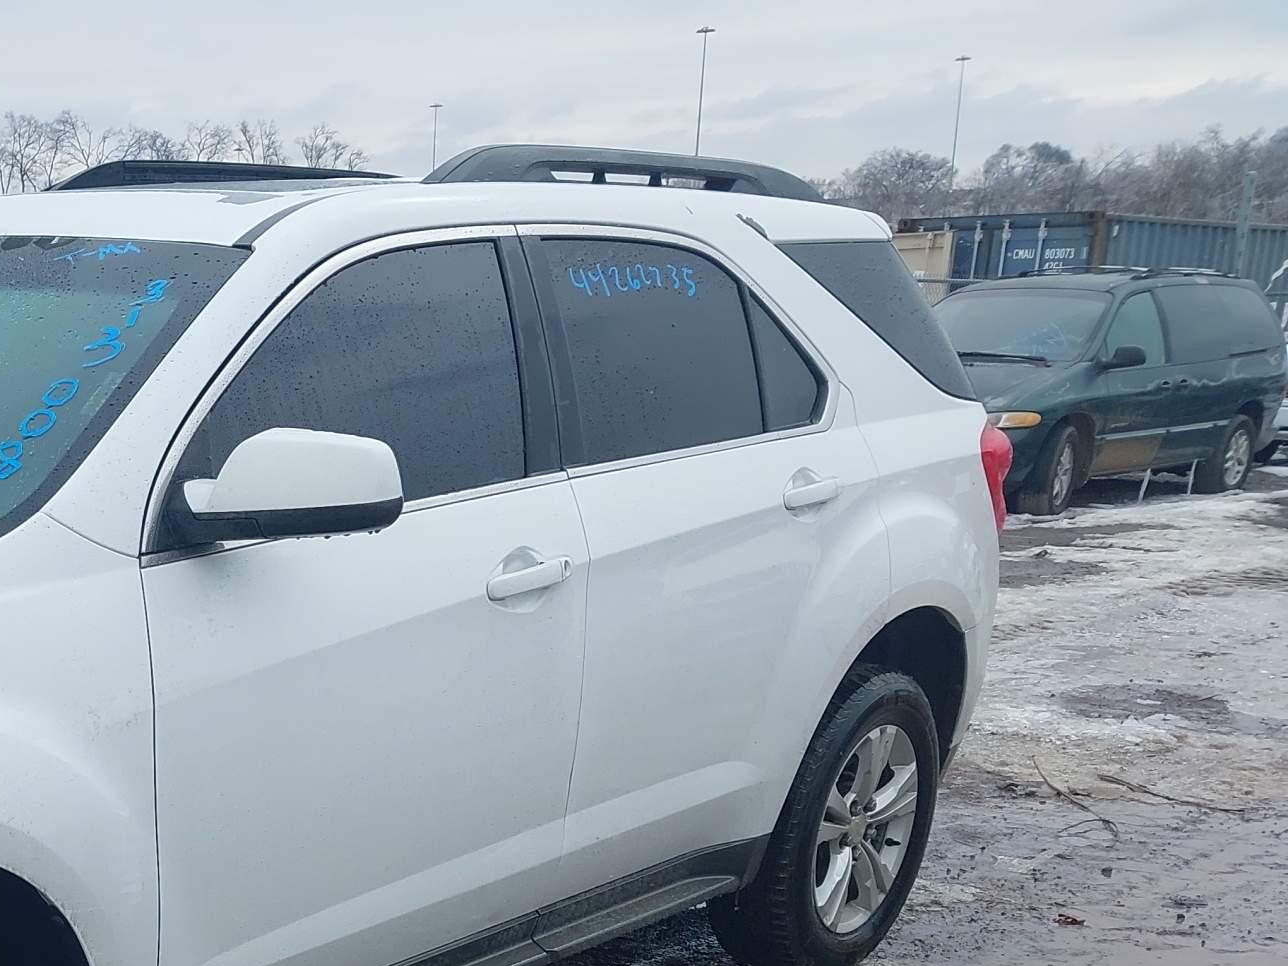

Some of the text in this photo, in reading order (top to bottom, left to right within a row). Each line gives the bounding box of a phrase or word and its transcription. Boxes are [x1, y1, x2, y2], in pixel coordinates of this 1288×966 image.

[1012, 248, 1035, 259] CMAU
[1043, 247, 1075, 259] 803073
[568, 263, 697, 297] 44262735
